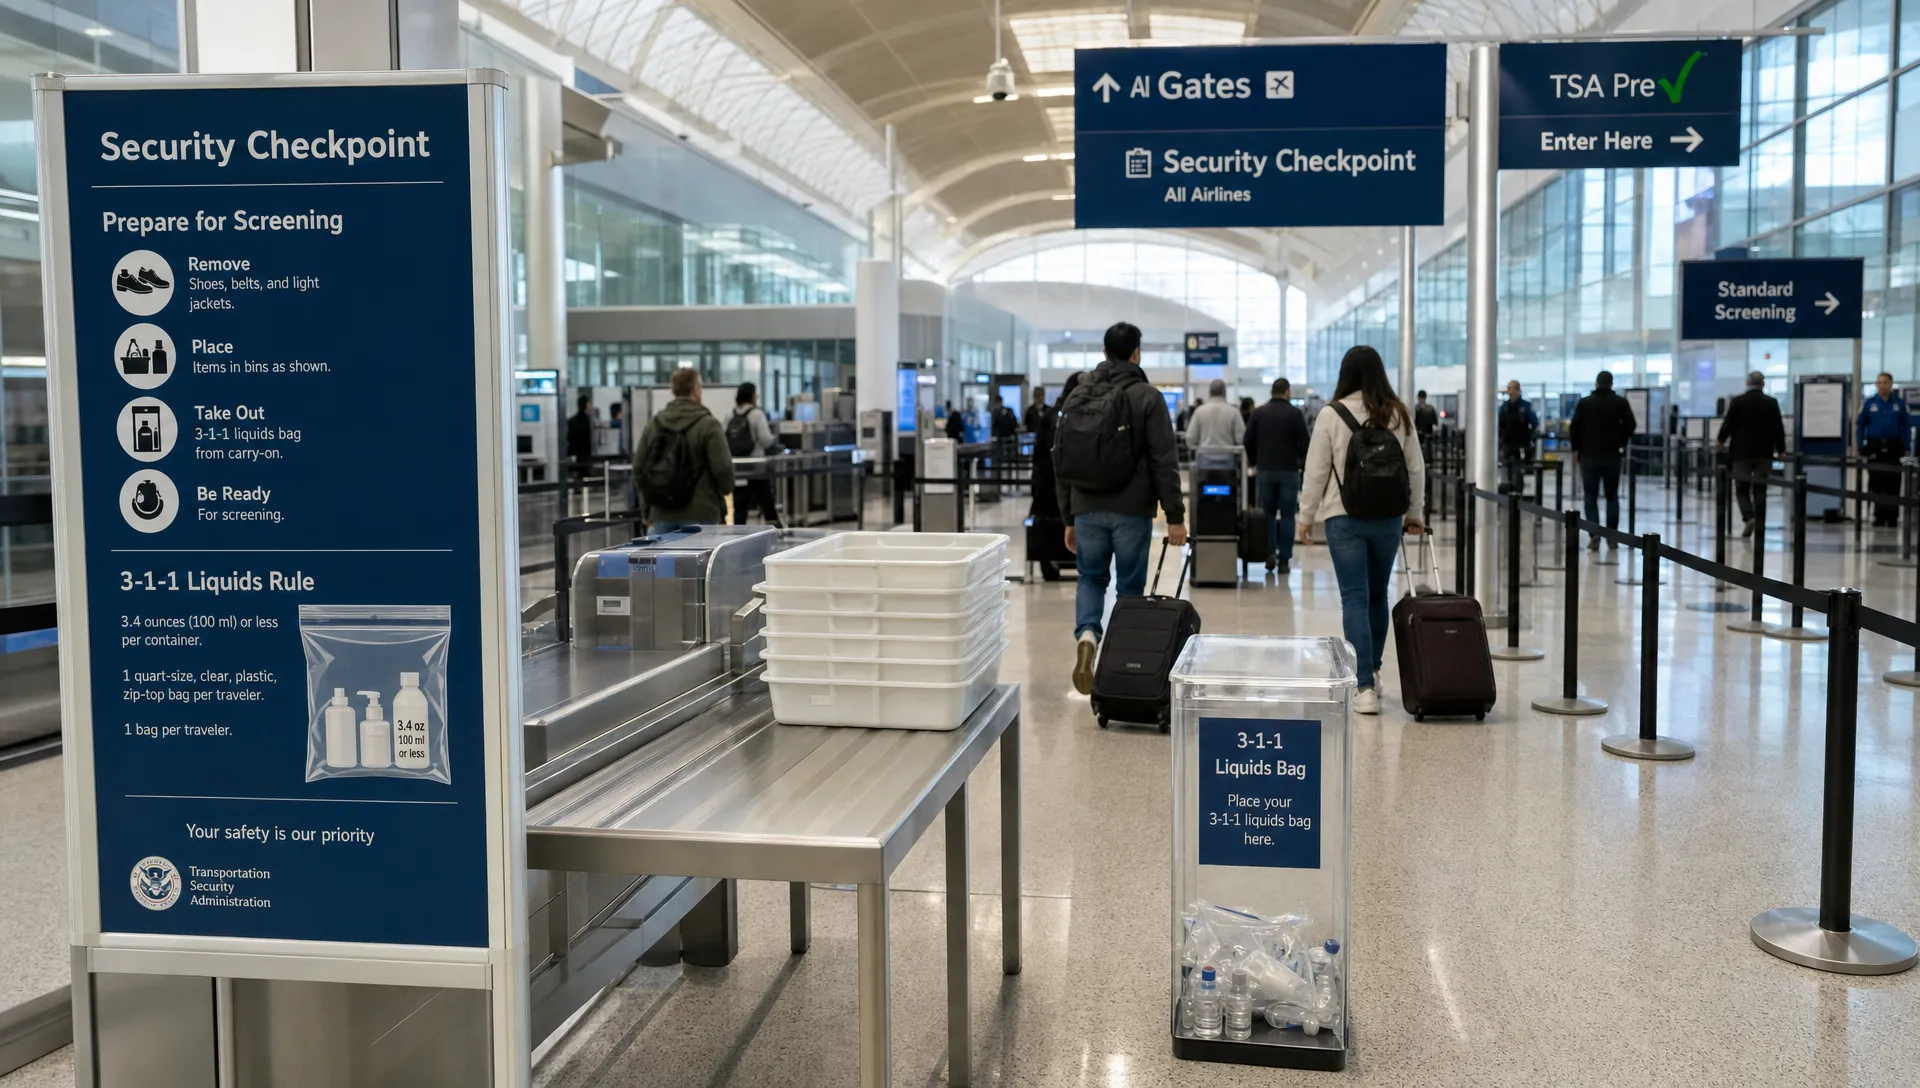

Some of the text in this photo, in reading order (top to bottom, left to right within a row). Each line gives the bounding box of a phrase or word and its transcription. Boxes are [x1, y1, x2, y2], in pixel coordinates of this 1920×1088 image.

[1158, 71, 1251, 99] Gates
[1550, 73, 1655, 98] TSA Pre
[101, 129, 430, 167] Security Checkpoint
[1542, 131, 1652, 150] Enter Here
[1164, 148, 1416, 177] Security Checkpoint
[1164, 187, 1251, 202] All Airlines
[103, 209, 342, 237] Prepare for Screening
[189, 257, 250, 271] Remove
[190, 276, 319, 291] Shoes, belts, and light
[1719, 281, 1793, 297] Standard
[190, 297, 234, 312] jackets.
[1715, 304, 1796, 323] Screening
[193, 339, 233, 353] Place
[194, 360, 330, 373] Items in bins as shown.
[195, 405, 264, 420] Take Out
[196, 427, 300, 442] 3-1-1 liquids bag
[196, 447, 282, 461] from carry-on.
[198, 486, 270, 504] Be Ready
[199, 508, 284, 523] For screening.
[121, 571, 314, 595] 3-1-1 Liquids Rule
[122, 615, 278, 629] 3.4 ounces (100 ml) or less
[122, 634, 201, 648] per container.
[123, 670, 276, 684] 1 quart-size, clear, plastic,
[124, 688, 263, 703] zip-top bag per traveler.
[125, 723, 232, 738] 1 bag per traveler.
[398, 720, 424, 731] 3.4 oz
[399, 735, 424, 744] 100 ml
[1238, 732, 1282, 749] 3-1-1
[410, 749, 425, 758] less
[1216, 759, 1305, 780] Liquids Bag
[1229, 794, 1292, 810] Place your
[1210, 813, 1310, 830] 3-1-1 liquids bag
[186, 824, 374, 846] Your safety is our priority
[1245, 832, 1274, 845] here.
[189, 866, 271, 880] Transportation
[190, 880, 235, 895] Security
[190, 894, 271, 908] Administration
